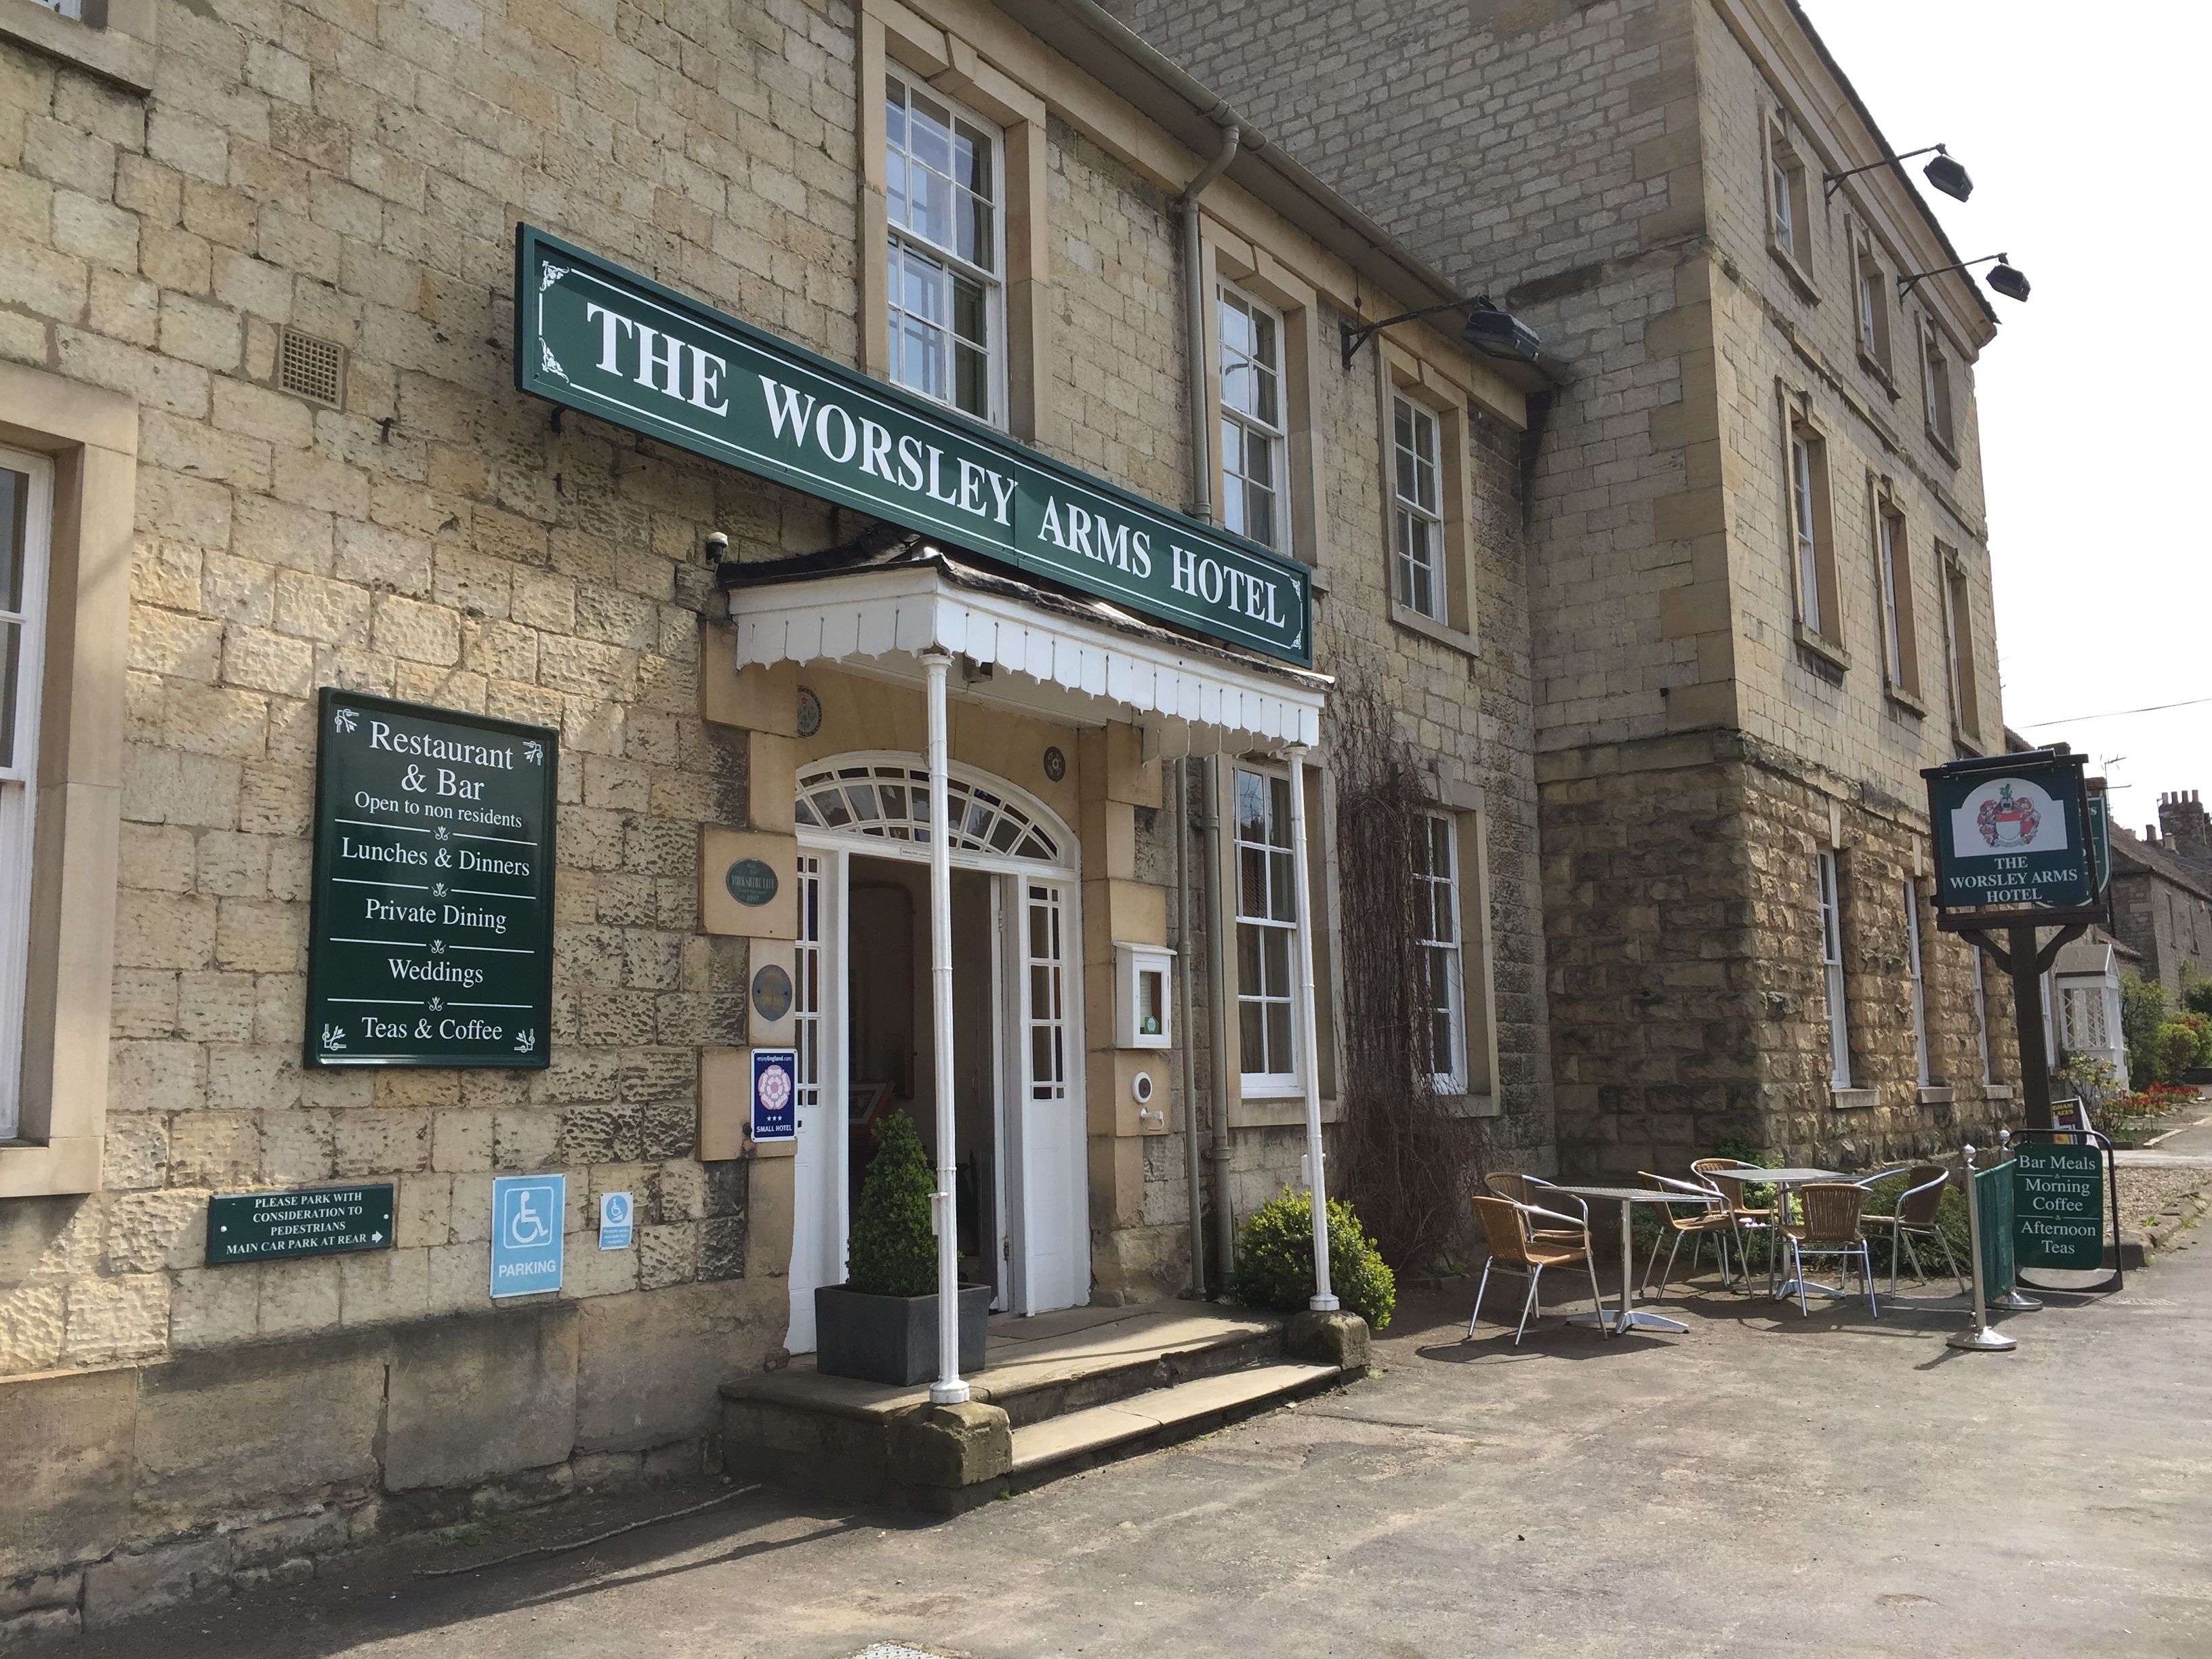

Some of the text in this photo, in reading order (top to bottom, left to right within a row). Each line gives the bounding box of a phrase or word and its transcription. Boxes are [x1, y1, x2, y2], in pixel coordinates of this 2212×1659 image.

[587, 302, 1286, 629] THE WORSLEY ARMS HOTEL
[369, 720, 514, 770] Restaurant
[401, 764, 485, 800] & Bar
[354, 791, 522, 828] Open to non residents
[341, 837, 530, 876] Lunches & Dinners
[1994, 856, 2028, 870] THE
[1950, 869, 2078, 889] WORSLEY ARMS
[1986, 888, 2043, 903] HOTEL
[365, 898, 507, 934] Private Dining
[388, 958, 484, 988] Weddings
[361, 1017, 503, 1040] Teas & Coffee
[2019, 1155, 2095, 1170] Bar Meals
[2024, 1178, 2091, 1197] Morning
[255, 1192, 362, 1208] PLEASE PARK WITH
[2033, 1197, 2083, 1212] Coffee
[253, 1206, 363, 1223] CONSIDERATION TO
[270, 1221, 346, 1236] PEDESTRIANS
[2021, 1221, 2096, 1237] Afternoon
[226, 1233, 367, 1254] MAIN CAR PARK AT REAR
[2041, 1240, 2075, 1254] Teas
[499, 1259, 556, 1277] PARKING
